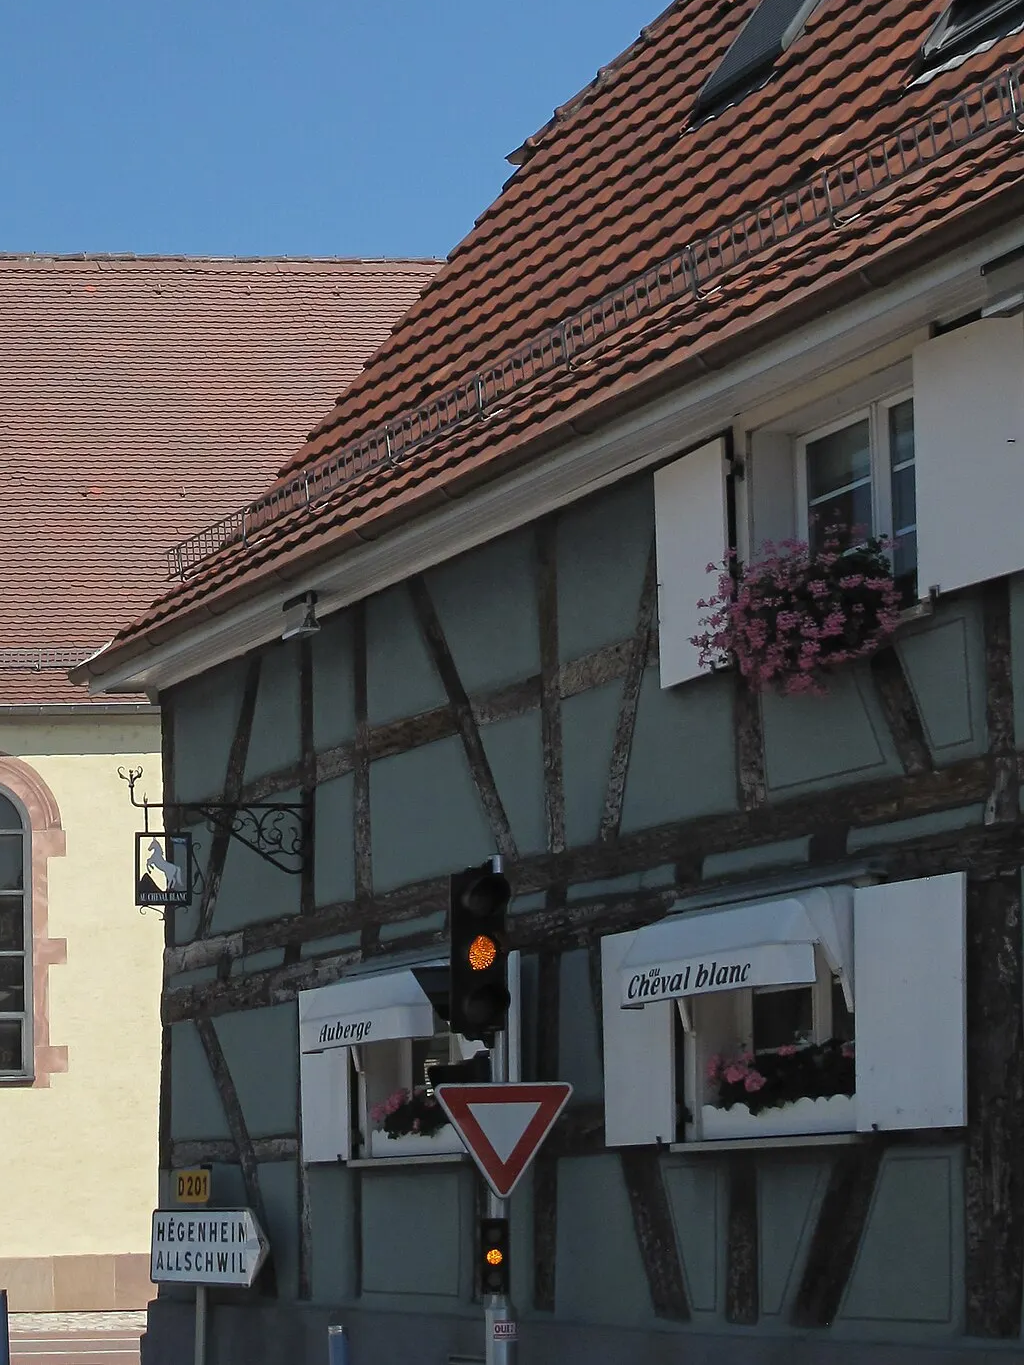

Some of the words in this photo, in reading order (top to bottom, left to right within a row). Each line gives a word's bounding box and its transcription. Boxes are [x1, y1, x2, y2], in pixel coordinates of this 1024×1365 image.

[147, 892, 168, 902] CHEVAL
[169, 892, 187, 902] BLANC
[627, 965, 691, 1000] Cheval
[695, 961, 751, 988] blanc
[648, 967, 661, 978] au
[318, 1020, 372, 1043] Auberge
[156, 1250, 246, 1274] ALLSCHWIL
